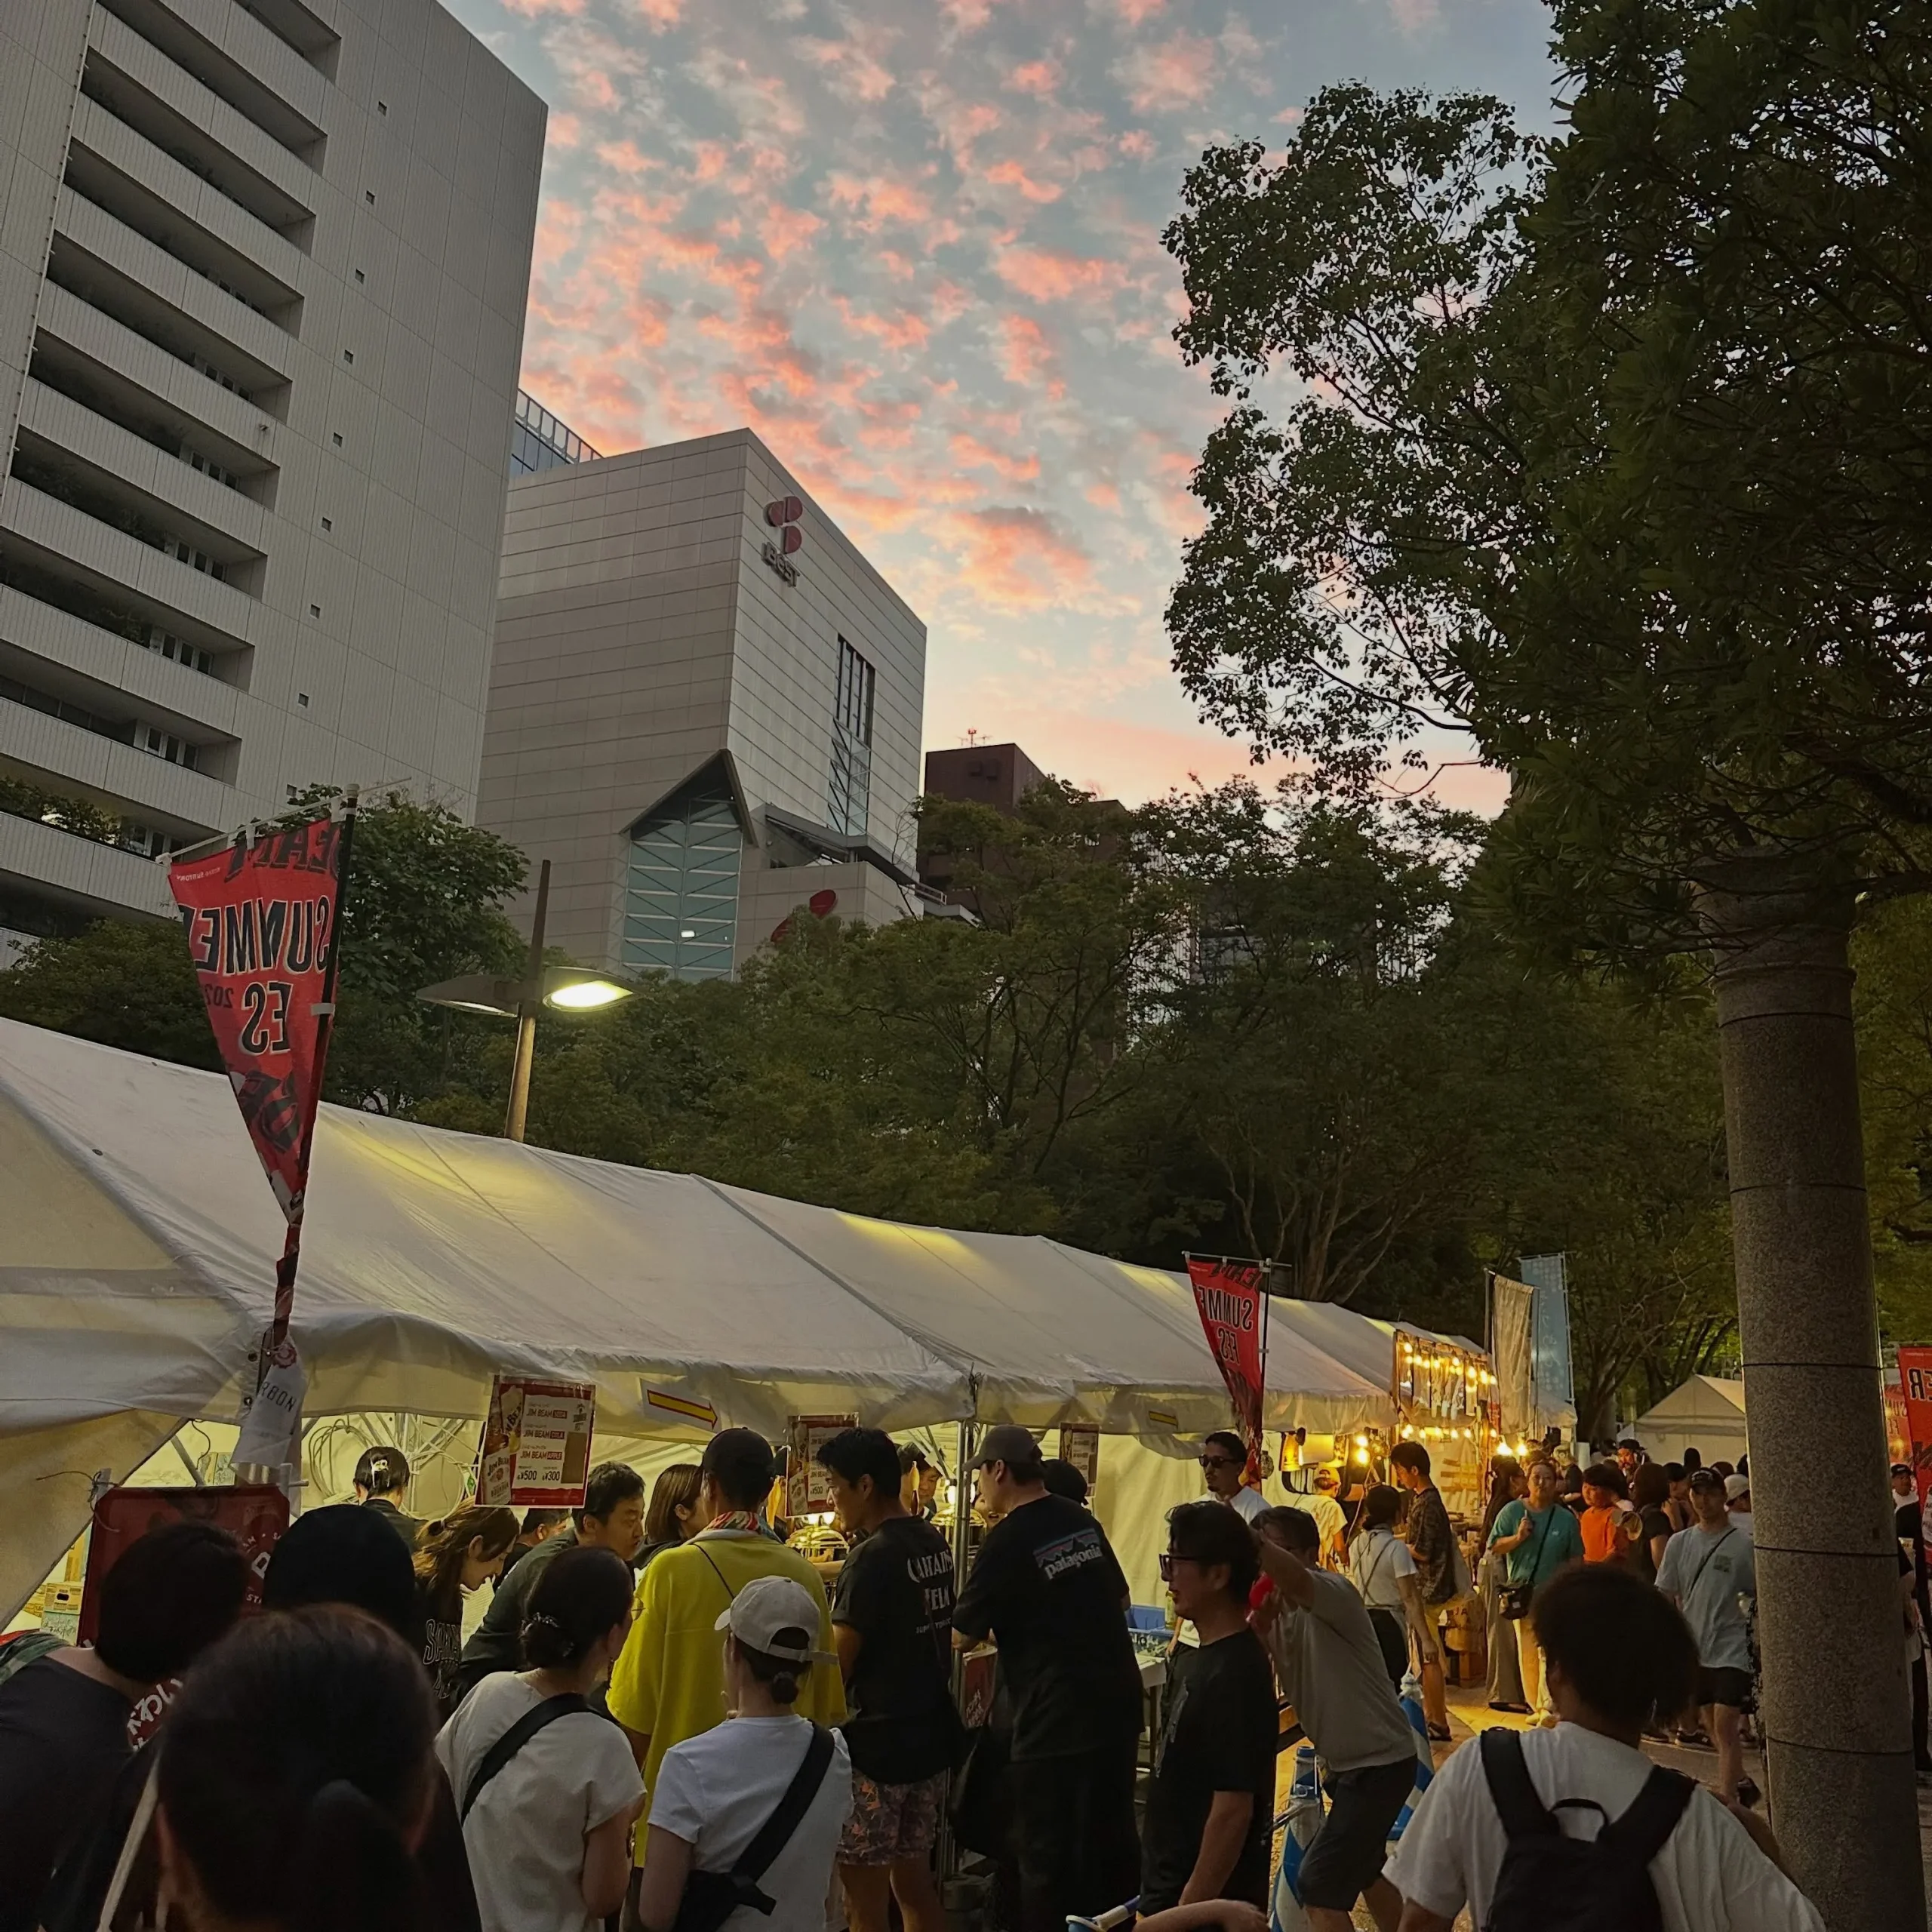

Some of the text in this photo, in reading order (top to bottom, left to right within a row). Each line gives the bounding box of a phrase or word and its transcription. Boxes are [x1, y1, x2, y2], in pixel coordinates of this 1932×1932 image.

[526, 1408, 537, 1417] JIM
[537, 1409, 552, 1417] BEAM
[523, 1430, 534, 1438] JIM
[534, 1430, 549, 1438] BEAM
[520, 1451, 531, 1459] JIM
[531, 1451, 547, 1460] BEAM
[1044, 1545, 1103, 1580] patagonia
